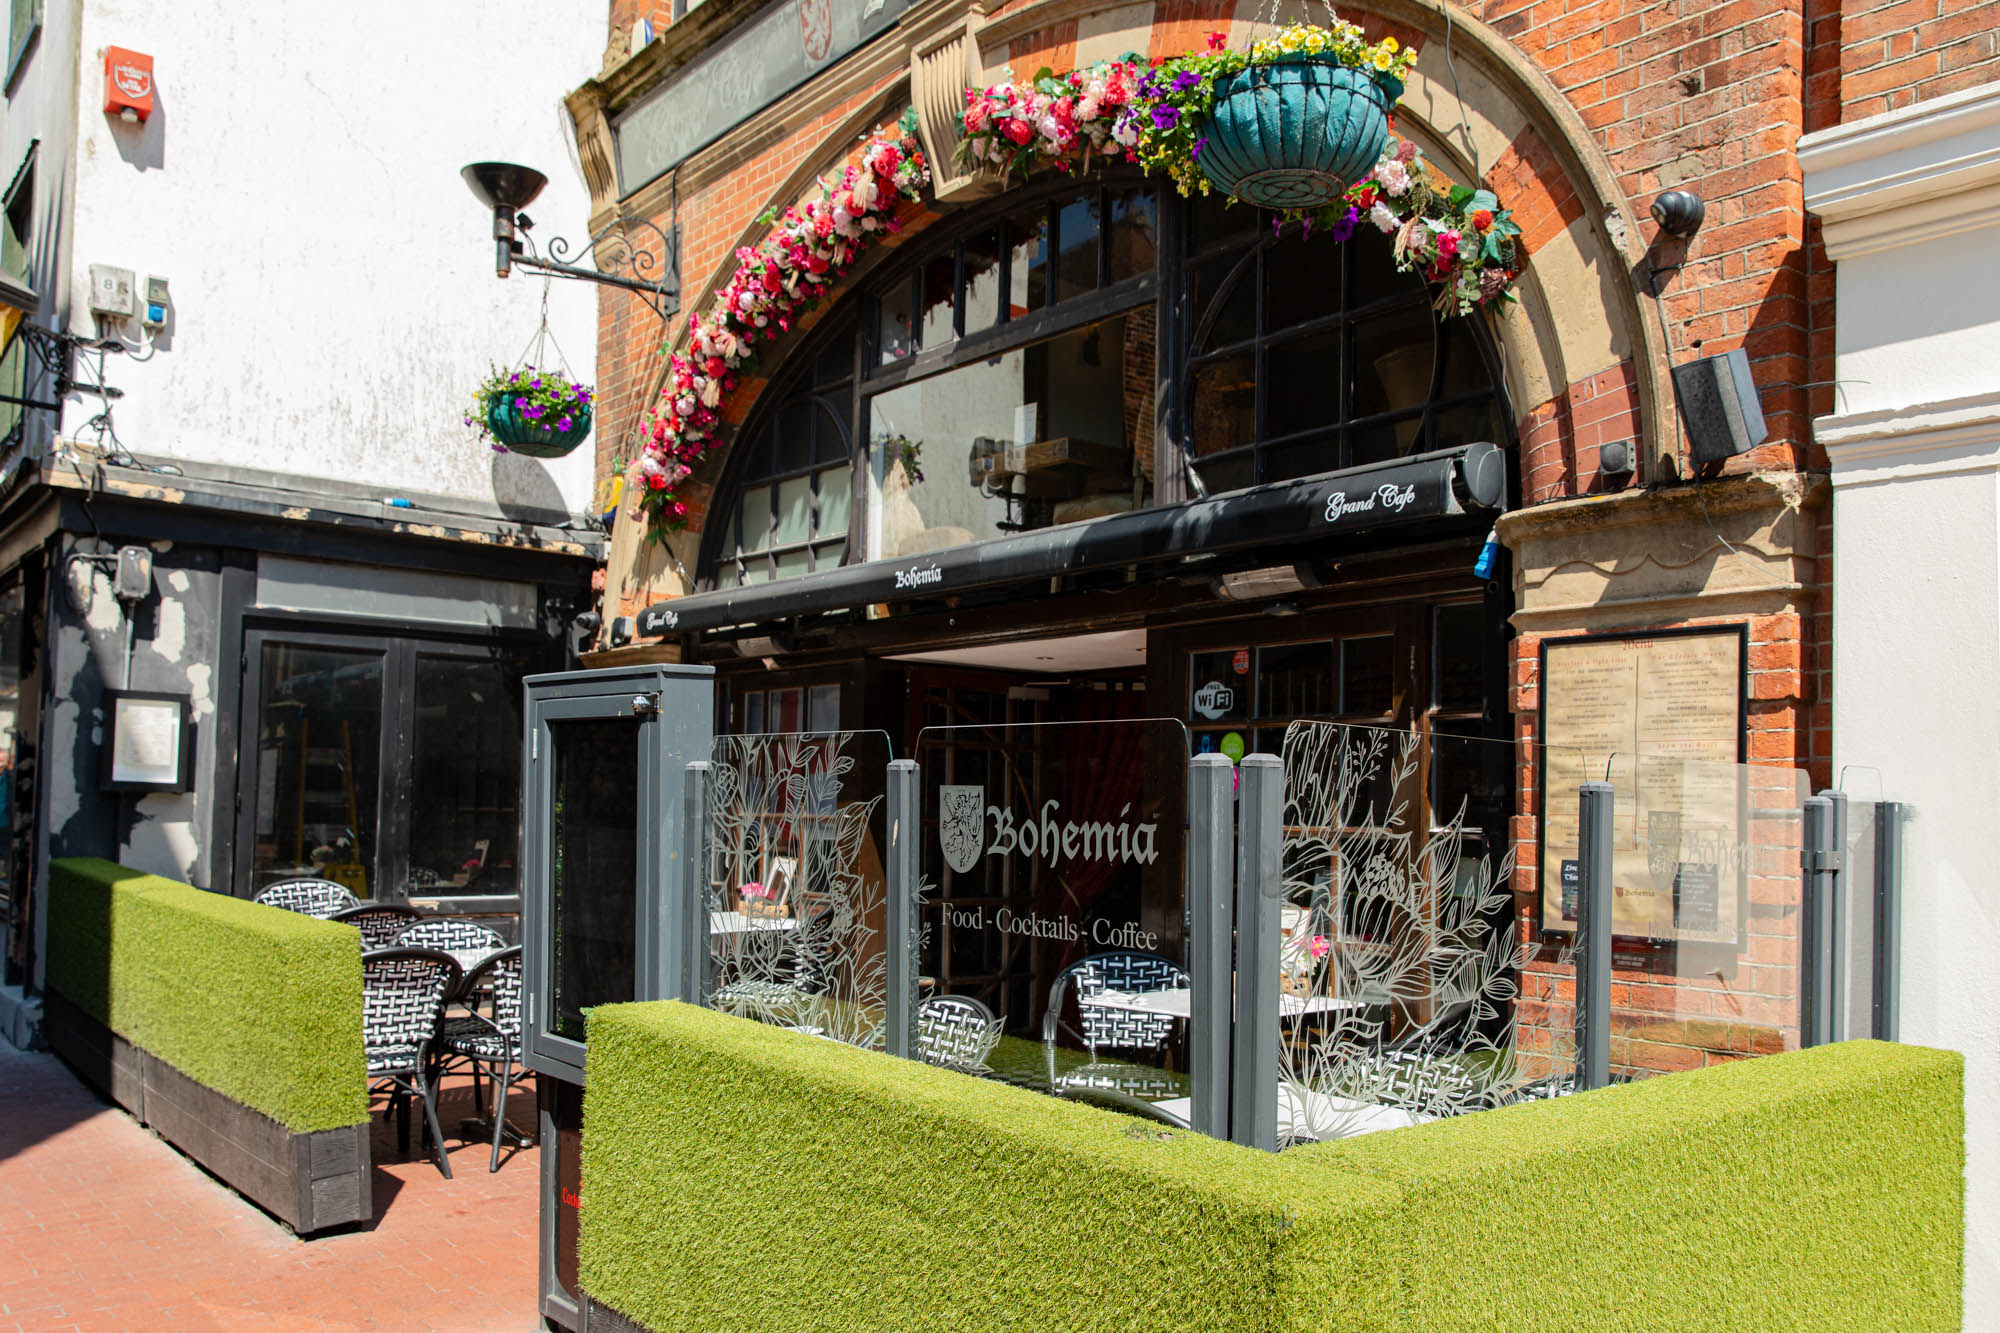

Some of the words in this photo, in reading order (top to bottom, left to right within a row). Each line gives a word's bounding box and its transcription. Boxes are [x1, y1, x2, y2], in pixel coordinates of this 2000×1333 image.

[1324, 491, 1377, 522] Grand
[1378, 483, 1416, 513] Cafe
[941, 902, 983, 929] Food
[995, 907, 1078, 941] Cocktails
[1092, 917, 1158, 950] Coffee
